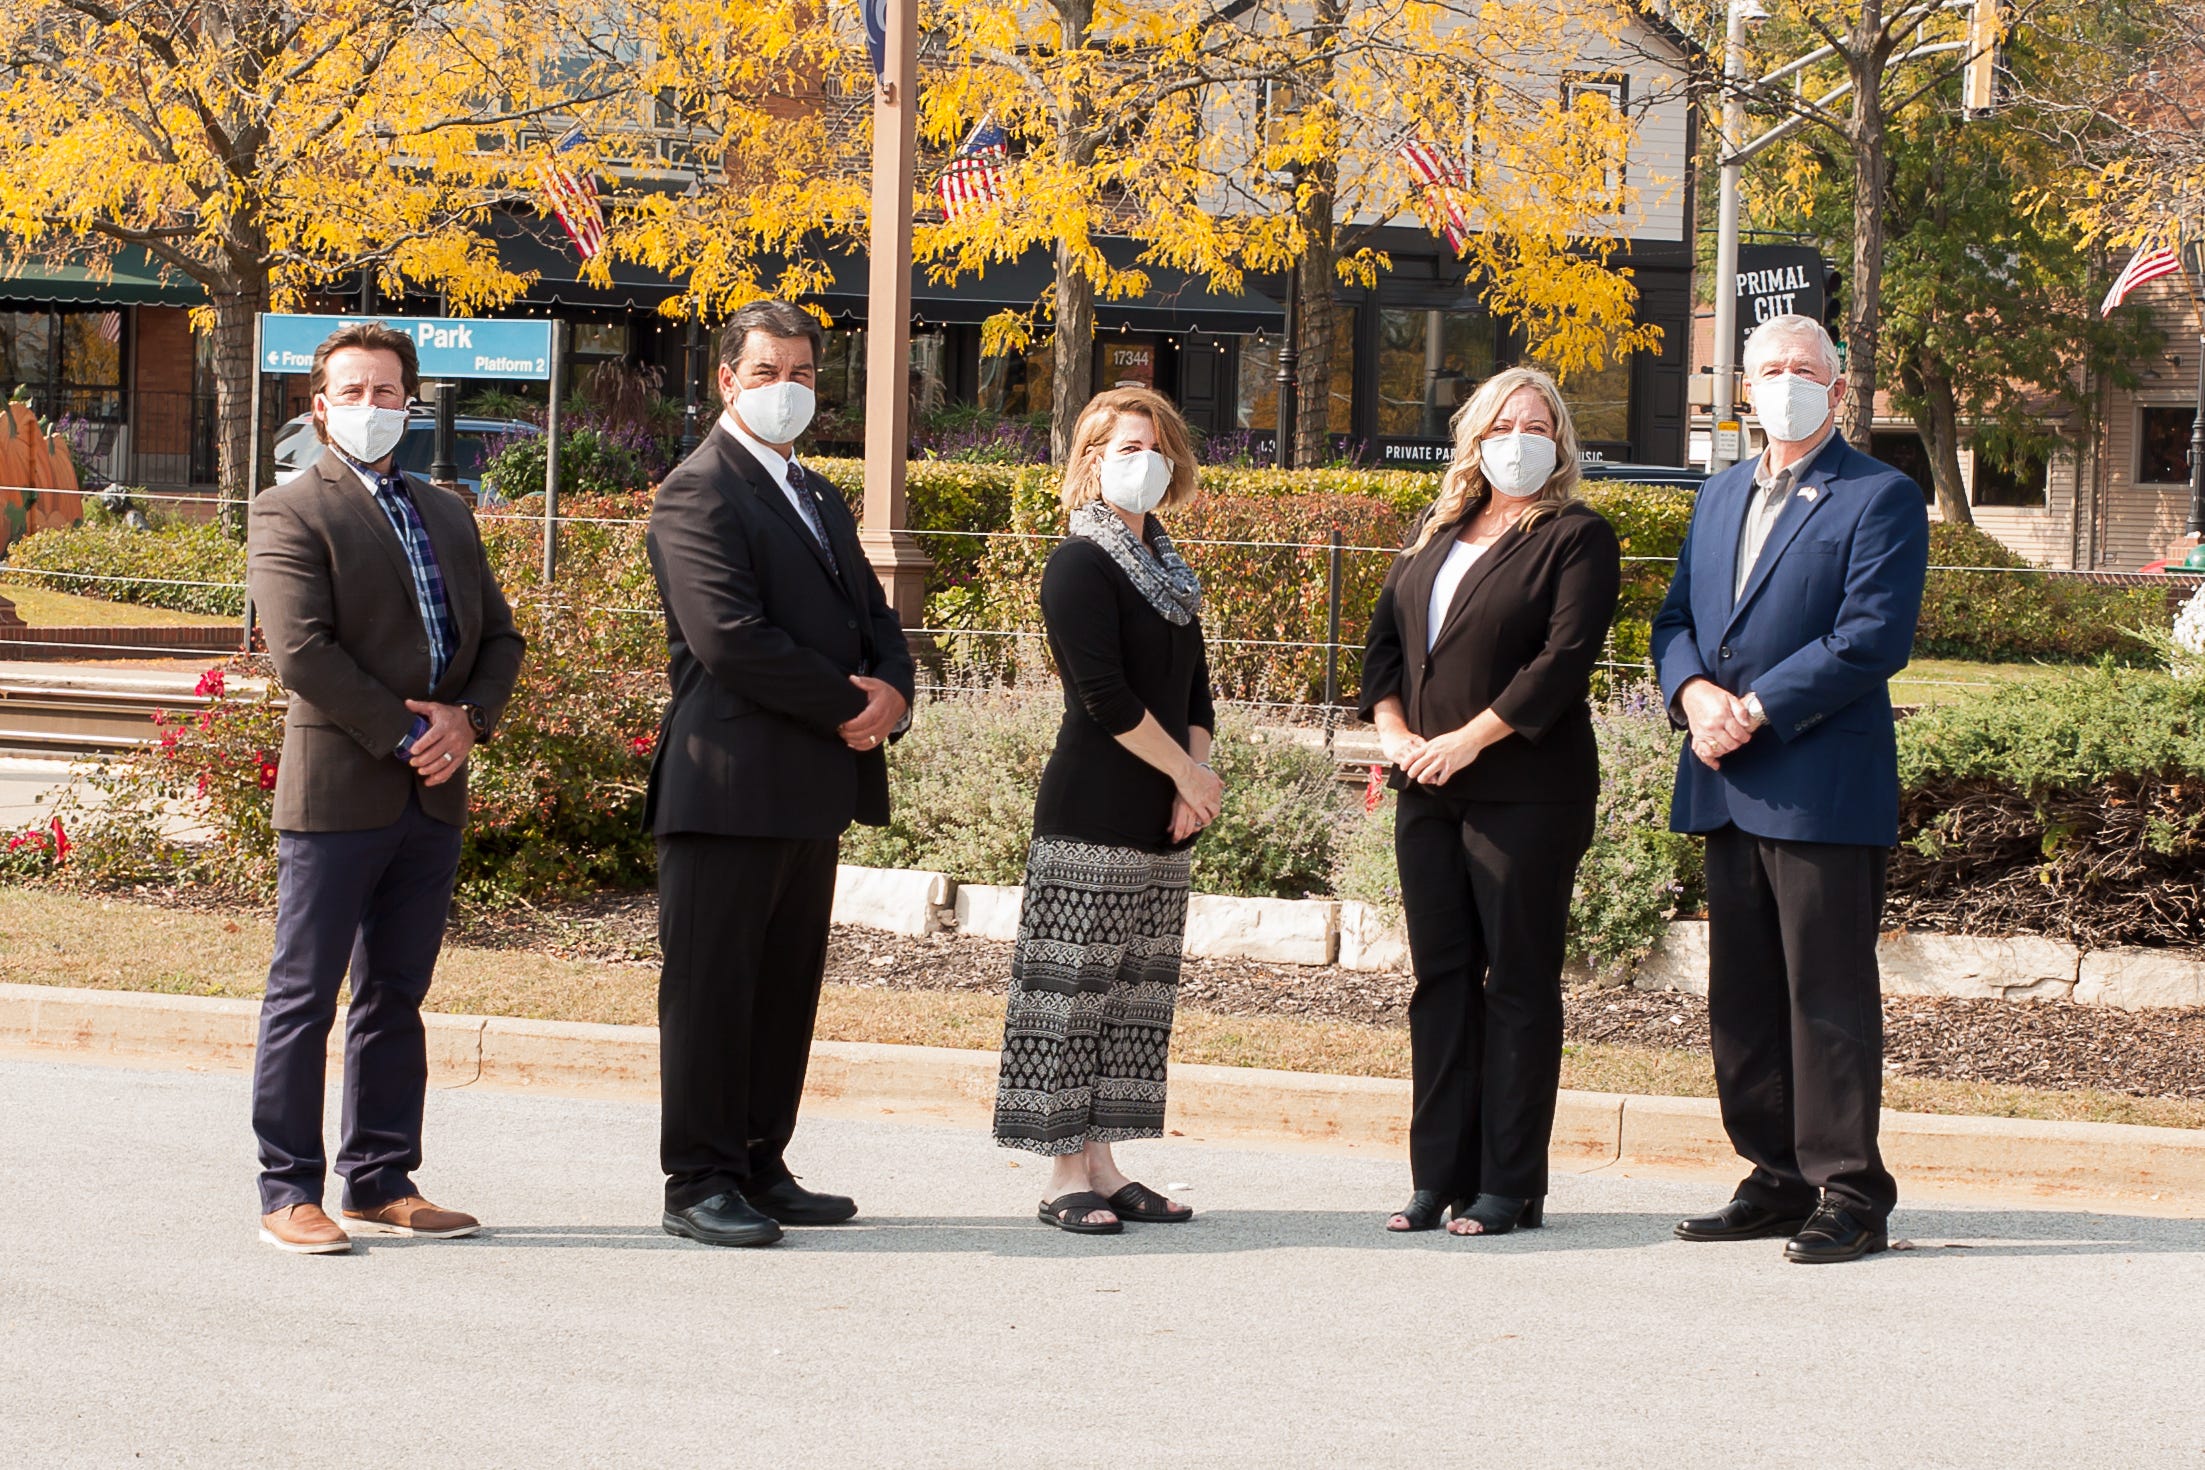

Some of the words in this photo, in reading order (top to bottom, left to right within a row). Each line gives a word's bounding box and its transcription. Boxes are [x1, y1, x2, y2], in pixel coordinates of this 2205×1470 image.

[1736, 265, 1811, 297] PRIMAL
[1754, 293, 1796, 324] CUT
[417, 323, 473, 349] Park
[474, 356, 533, 372] Platform
[535, 358, 546, 373] 2
[1113, 350, 1149, 366] 17344
[1385, 445, 1433, 460] PRIVATE
